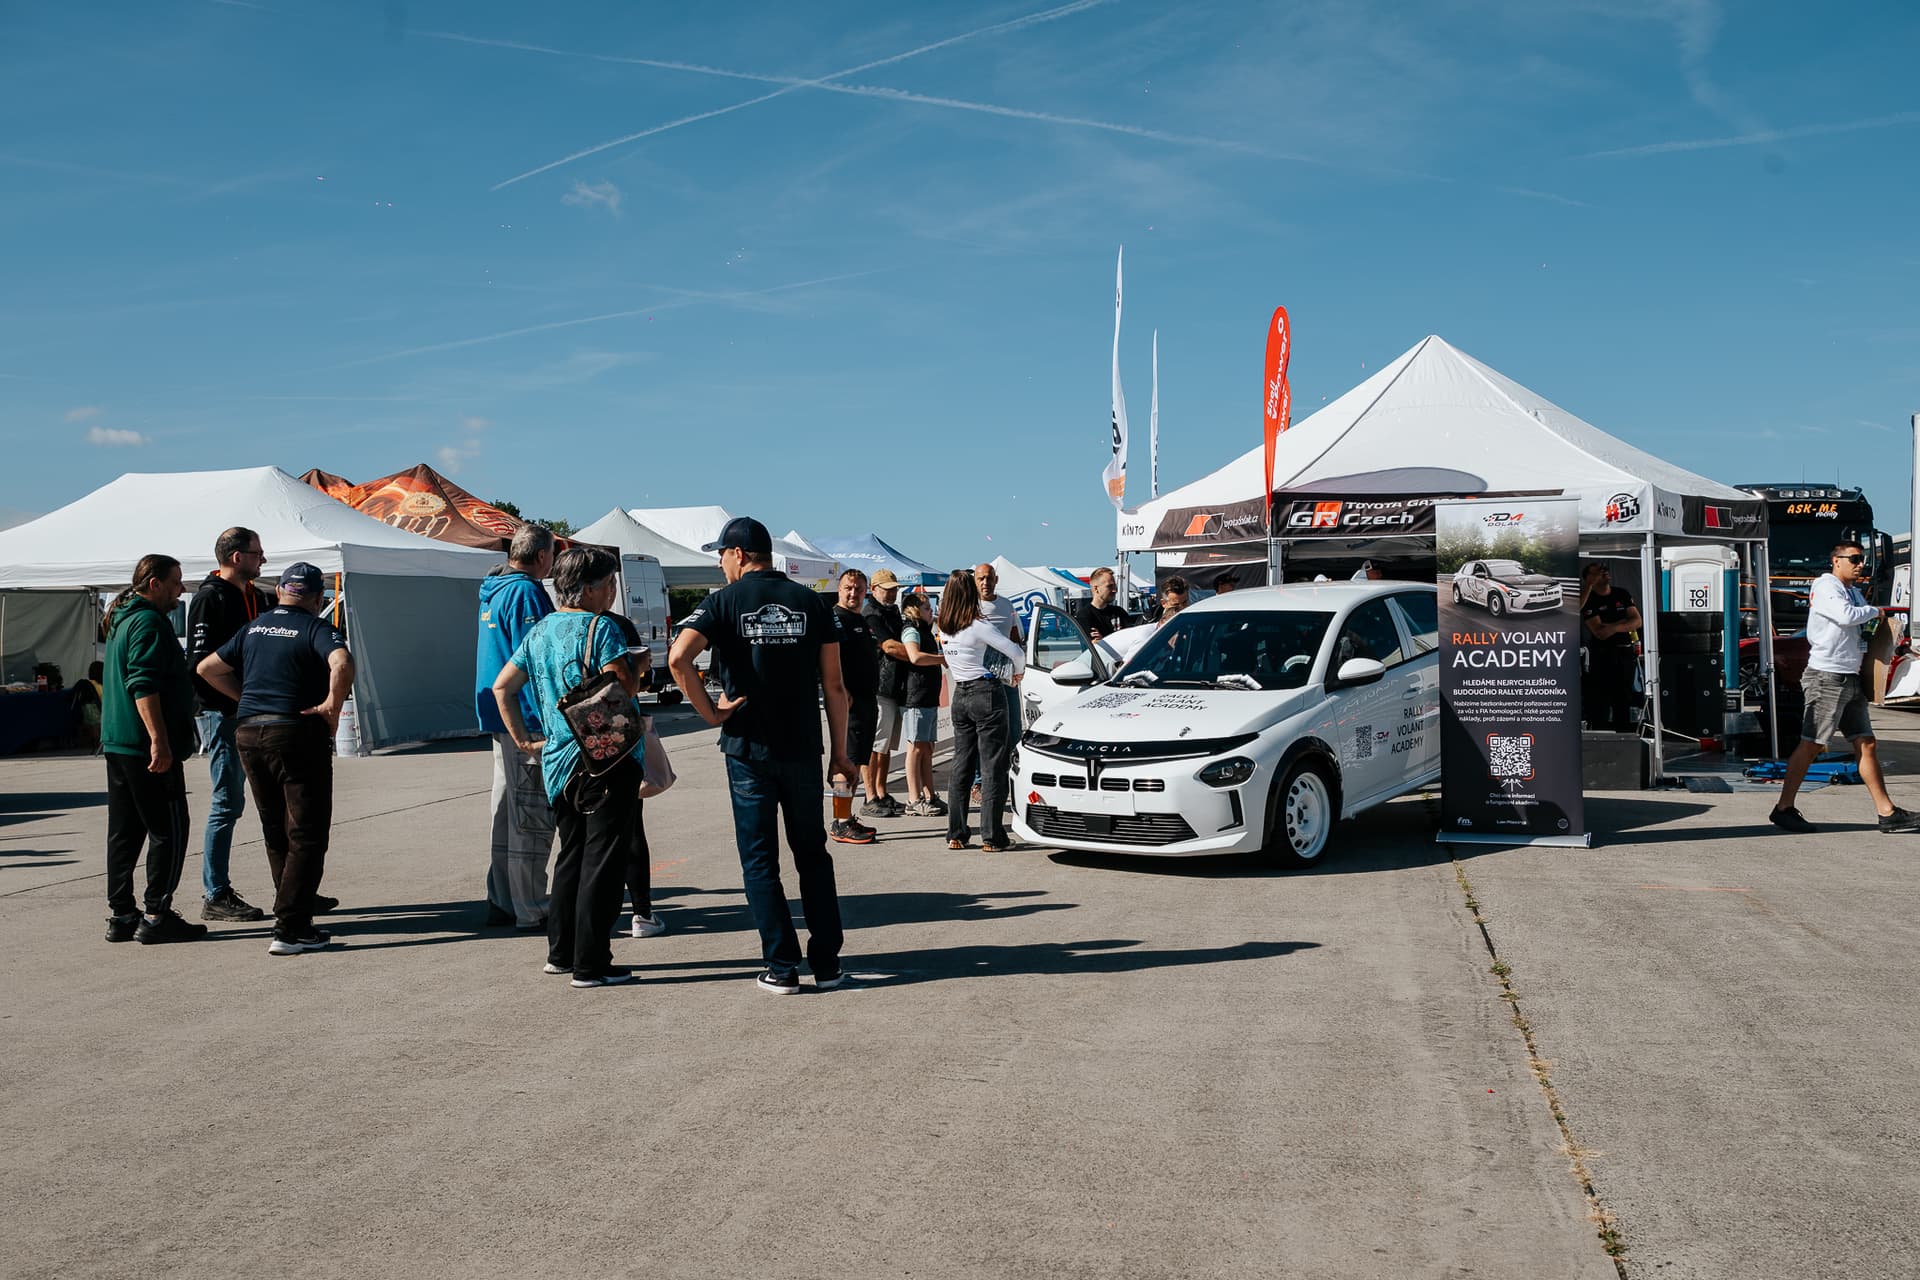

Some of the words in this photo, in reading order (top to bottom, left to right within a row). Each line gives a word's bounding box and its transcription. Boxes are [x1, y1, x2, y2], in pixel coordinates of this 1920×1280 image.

[1272, 330, 1288, 419] V-Power
[1267, 379, 1276, 418] Shell
[1346, 501, 1402, 510] TOYOTA
[1606, 497, 1640, 522] #53
[1290, 511, 1338, 526] GR
[1342, 511, 1415, 526] Czech
[1815, 511, 1839, 520] racing
[1689, 586, 1708, 599] TOI
[1689, 599, 1708, 608] TOI
[1452, 632, 1499, 646] RALLY
[1501, 632, 1566, 645] VOLANT
[1452, 649, 1567, 668] ACADEMY
[1462, 678, 1496, 686] HLEDÁME
[1496, 678, 1557, 686] NEJRYCHLEJŠÍHO
[1453, 687, 1498, 696] BUDOUCÍHO
[1498, 688, 1524, 696] RALLYE
[1524, 687, 1567, 696] ZÁVODNÍKA
[1142, 703, 1208, 711] ACADEMY
[1403, 704, 1424, 719] RALLY
[1396, 720, 1425, 737] VOLANT
[1066, 743, 1132, 752] LANCIA
[1391, 736, 1424, 754] ACADEMY
